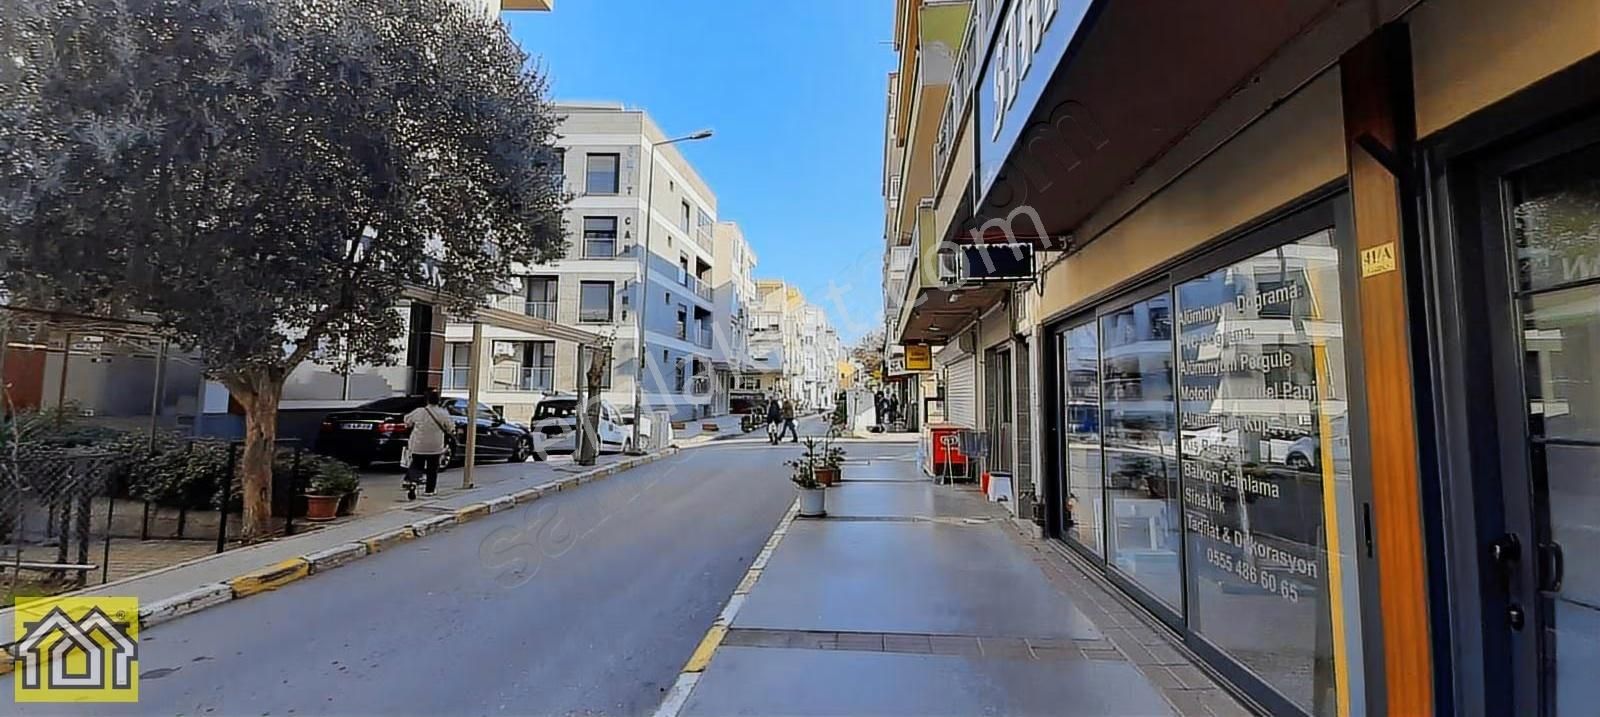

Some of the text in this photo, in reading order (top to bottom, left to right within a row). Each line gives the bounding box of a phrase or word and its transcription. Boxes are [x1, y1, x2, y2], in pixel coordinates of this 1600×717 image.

[1184, 463, 1219, 484] Balkon
[1185, 487, 1226, 514] Sineklik
[1222, 526, 1232, 544] &
[1207, 547, 1299, 603] 0555 486 60 65
